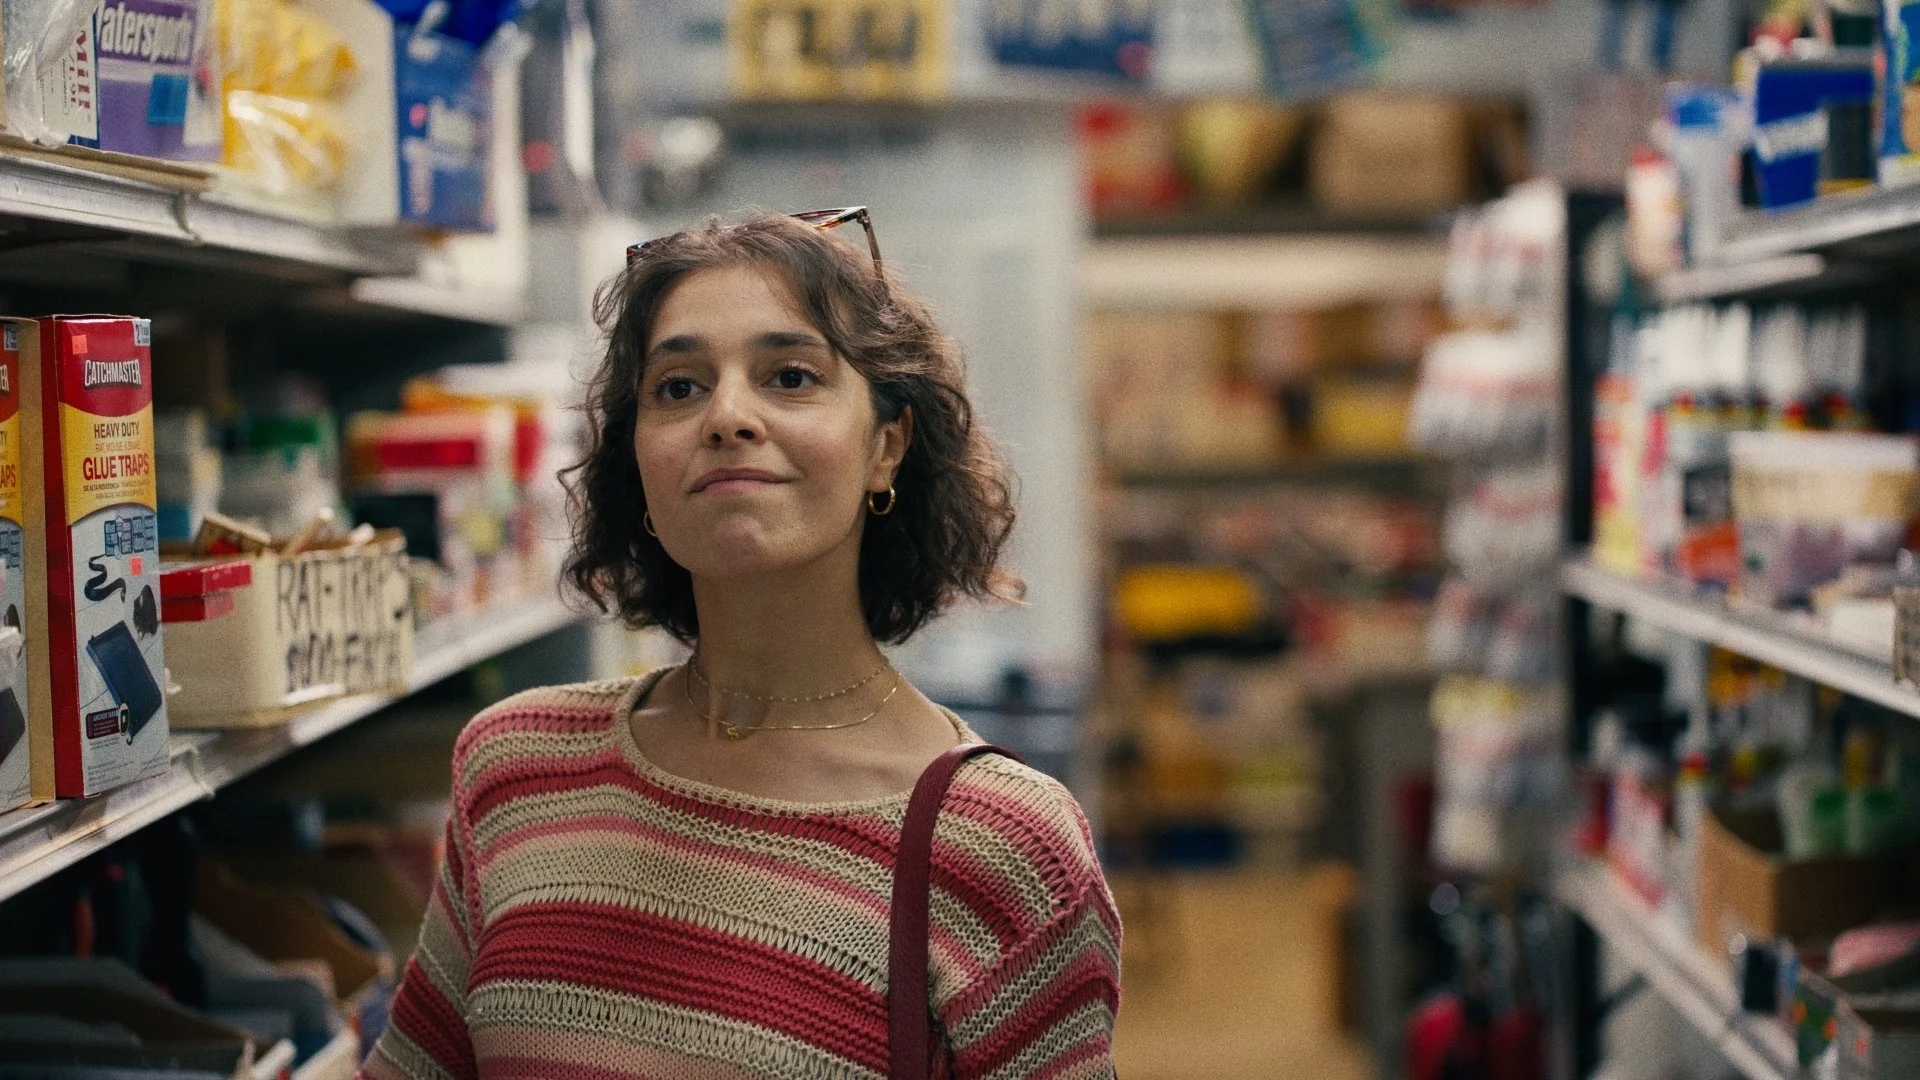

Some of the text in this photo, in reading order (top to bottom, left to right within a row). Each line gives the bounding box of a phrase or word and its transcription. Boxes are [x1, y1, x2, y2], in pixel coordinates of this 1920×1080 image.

[0, 364, 9, 391] ER
[84, 359, 141, 387] CATCHMASTER
[94, 422, 140, 439] HEAVY DUTY
[83, 453, 150, 481] GLUE TRAPS
